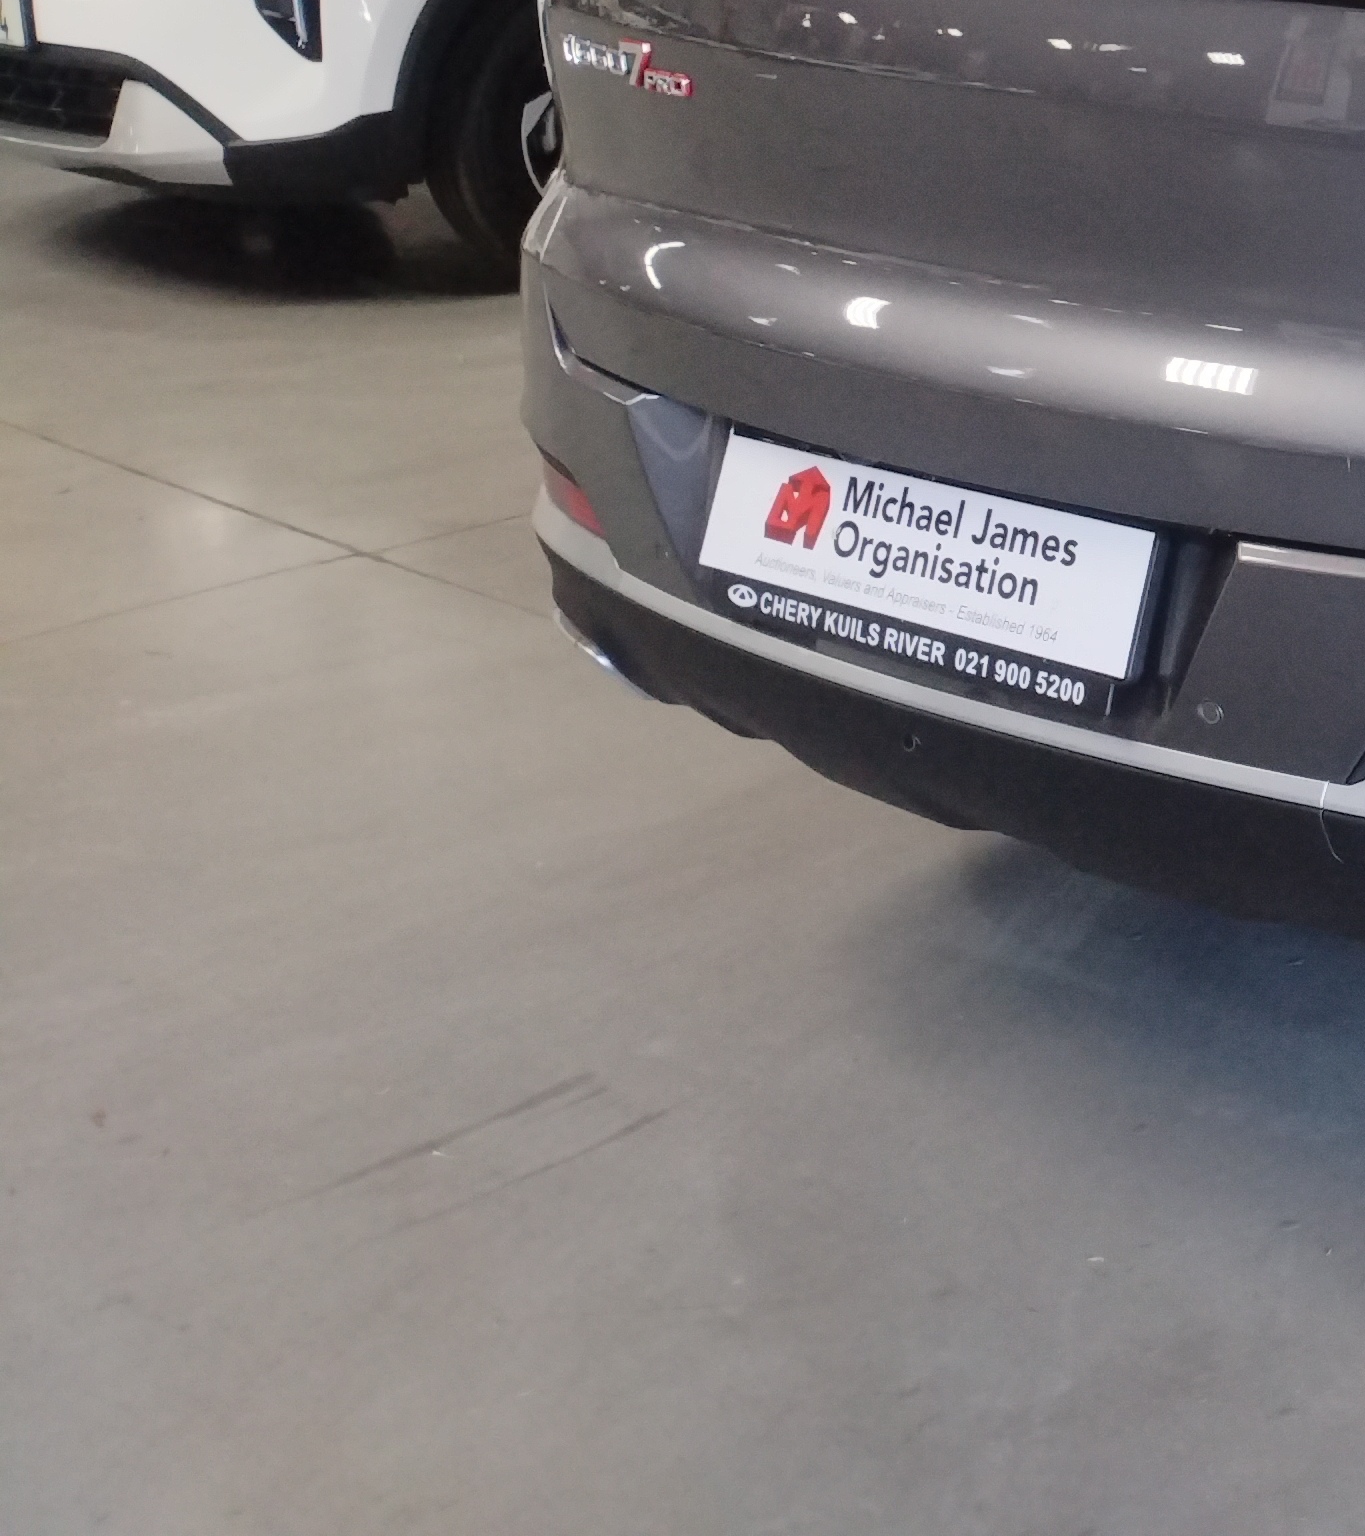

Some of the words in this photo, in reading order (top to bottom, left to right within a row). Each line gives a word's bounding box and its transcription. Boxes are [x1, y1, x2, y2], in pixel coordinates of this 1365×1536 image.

[644, 67, 694, 97] PRO
[833, 520, 1038, 606] Organisation
[842, 476, 966, 539] Michael
[971, 508, 1079, 566] James
[754, 552, 818, 582] Auctioneers,
[823, 570, 861, 593] Valuers
[864, 582, 885, 599] and
[887, 587, 947, 615] Appraisers
[956, 605, 1026, 635] Established
[1028, 624, 1059, 643] 1964
[760, 591, 823, 629] CHERY
[824, 610, 881, 646] KUILS
[883, 626, 946, 666] RIVER
[954, 648, 990, 679] 021
[994, 659, 1031, 690] 900
[1034, 670, 1085, 706] 5200
